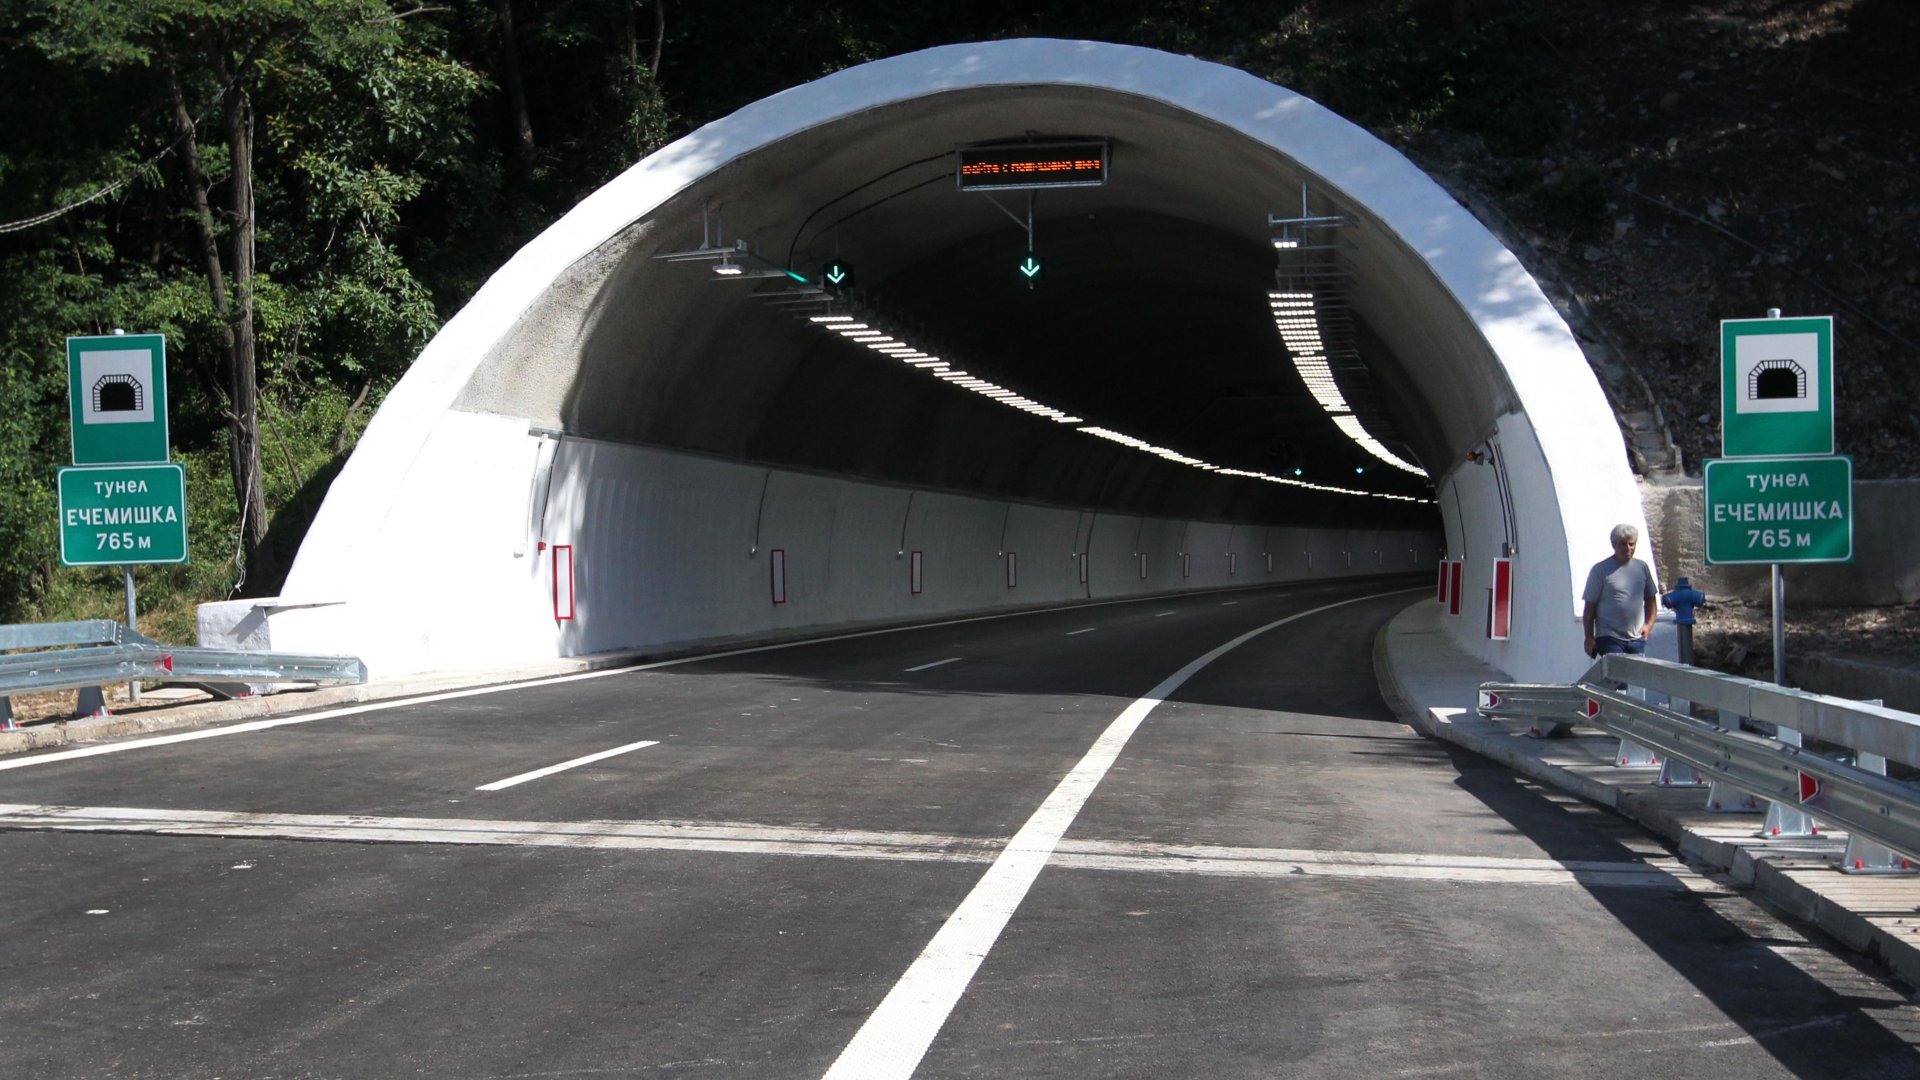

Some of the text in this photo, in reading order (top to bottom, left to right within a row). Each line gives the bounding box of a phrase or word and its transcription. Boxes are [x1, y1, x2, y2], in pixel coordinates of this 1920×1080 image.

[94, 480, 148, 498] тунел
[1746, 473, 1809, 492] тунел
[67, 506, 177, 526] ЕЧЕМИШКА
[1714, 501, 1843, 522] ЕЧЕМИШКА
[96, 532, 151, 550] 765 м
[1747, 529, 1811, 548] 765 м
